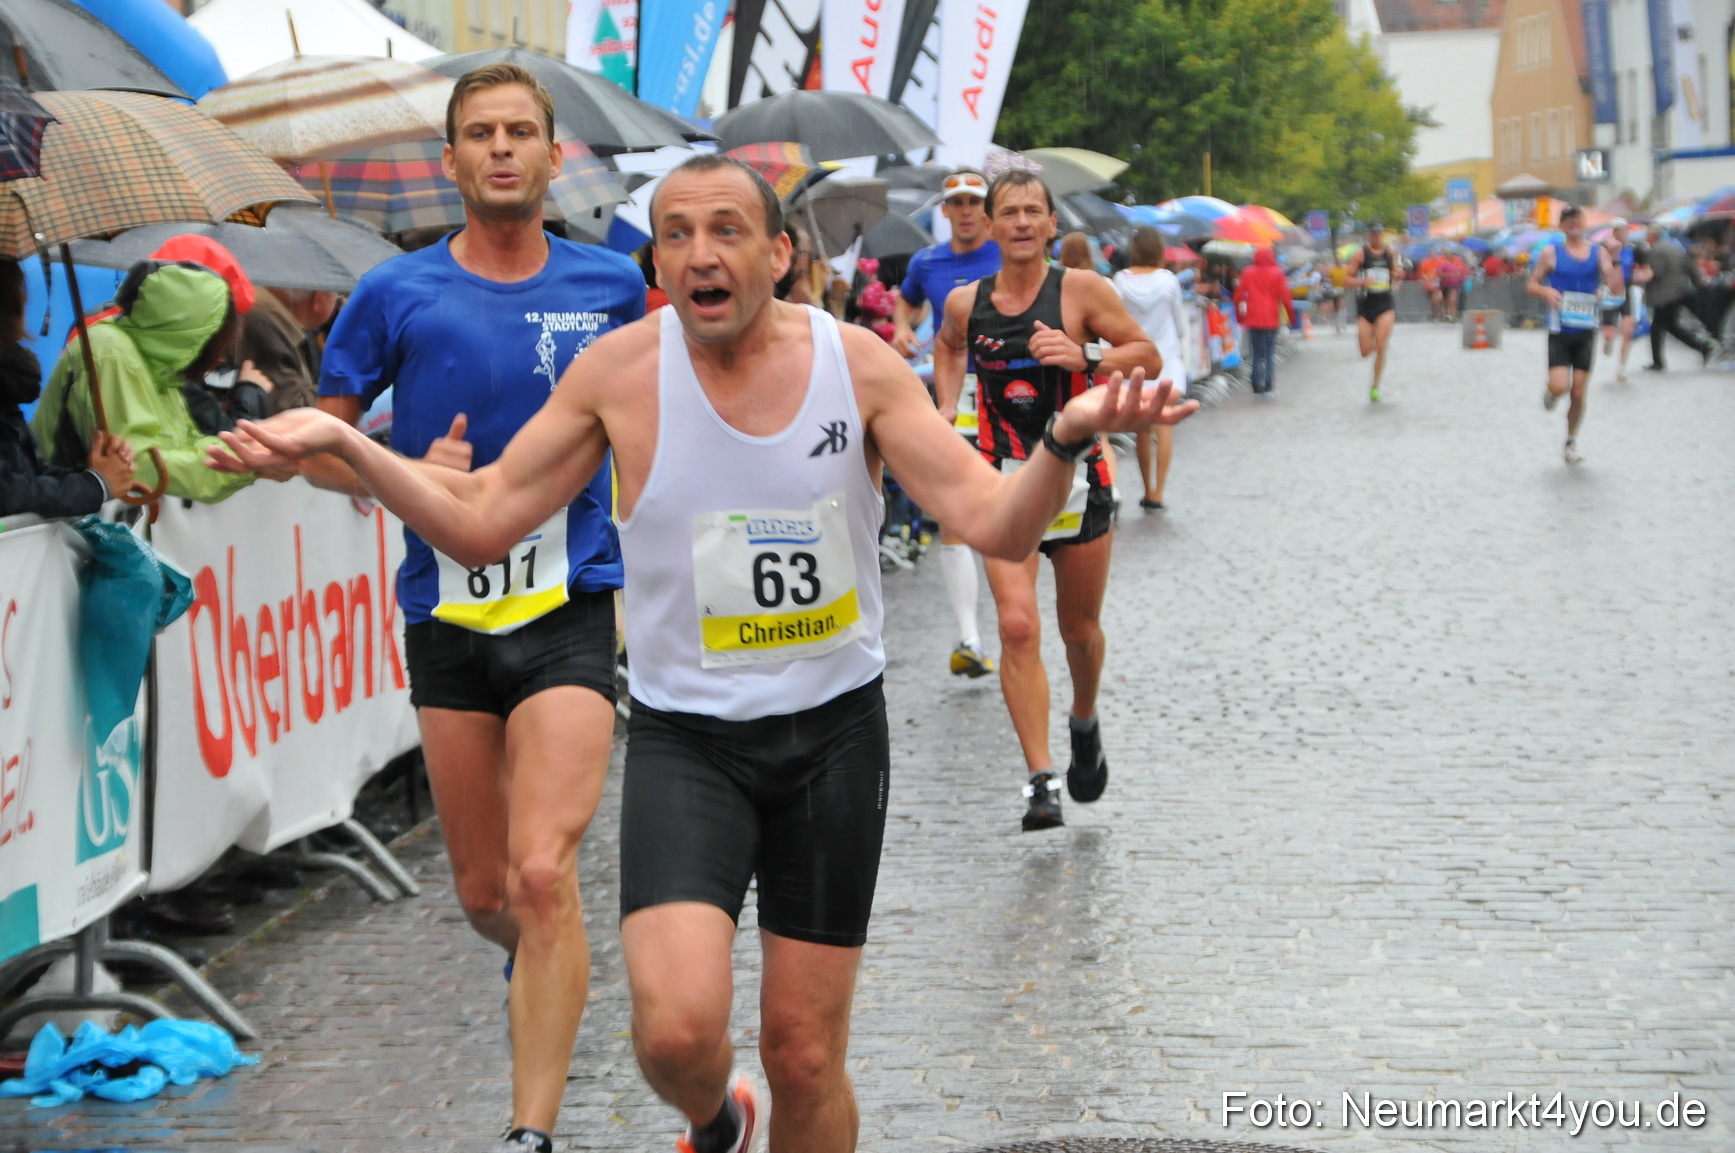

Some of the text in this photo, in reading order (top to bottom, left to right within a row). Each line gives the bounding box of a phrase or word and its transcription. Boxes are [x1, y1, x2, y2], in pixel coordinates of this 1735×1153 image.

[961, 4, 998, 121] Audi
[525, 312, 608, 323] 12. NEUMARKTER
[542, 322, 599, 331] STADTLAUF
[1007, 389, 1035, 397] SPORT
[752, 551, 822, 609] 63
[186, 506, 406, 780] Oberbank
[739, 613, 836, 645] Christian
